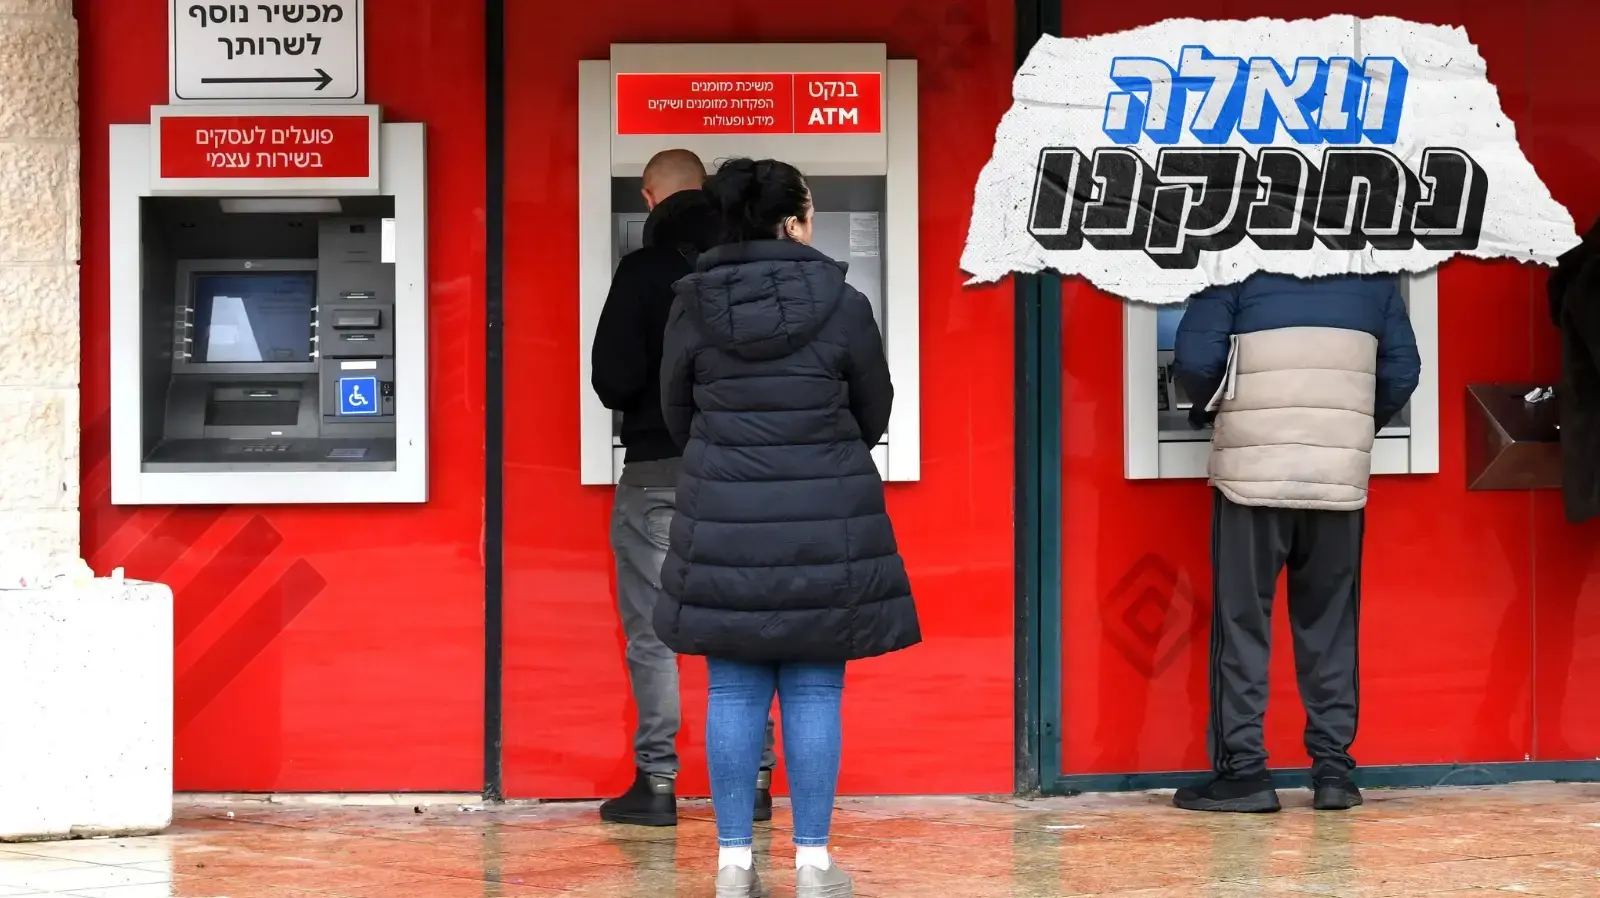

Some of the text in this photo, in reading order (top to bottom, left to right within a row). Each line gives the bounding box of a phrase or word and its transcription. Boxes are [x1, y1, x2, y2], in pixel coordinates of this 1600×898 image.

[188, 4, 344, 27] מכשיר נוסף
[218, 33, 322, 59] לשרותך
[691, 81, 774, 92] משיכת מזומנים
[808, 81, 858, 101] בנקט
[648, 98, 774, 111] הפקדות מזומנים ושיקים
[703, 115, 774, 126] מידע ופעולות
[808, 108, 858, 125] ATM
[196, 125, 334, 149] פועלים לעסקים
[206, 152, 323, 168] בשירות עצמי
